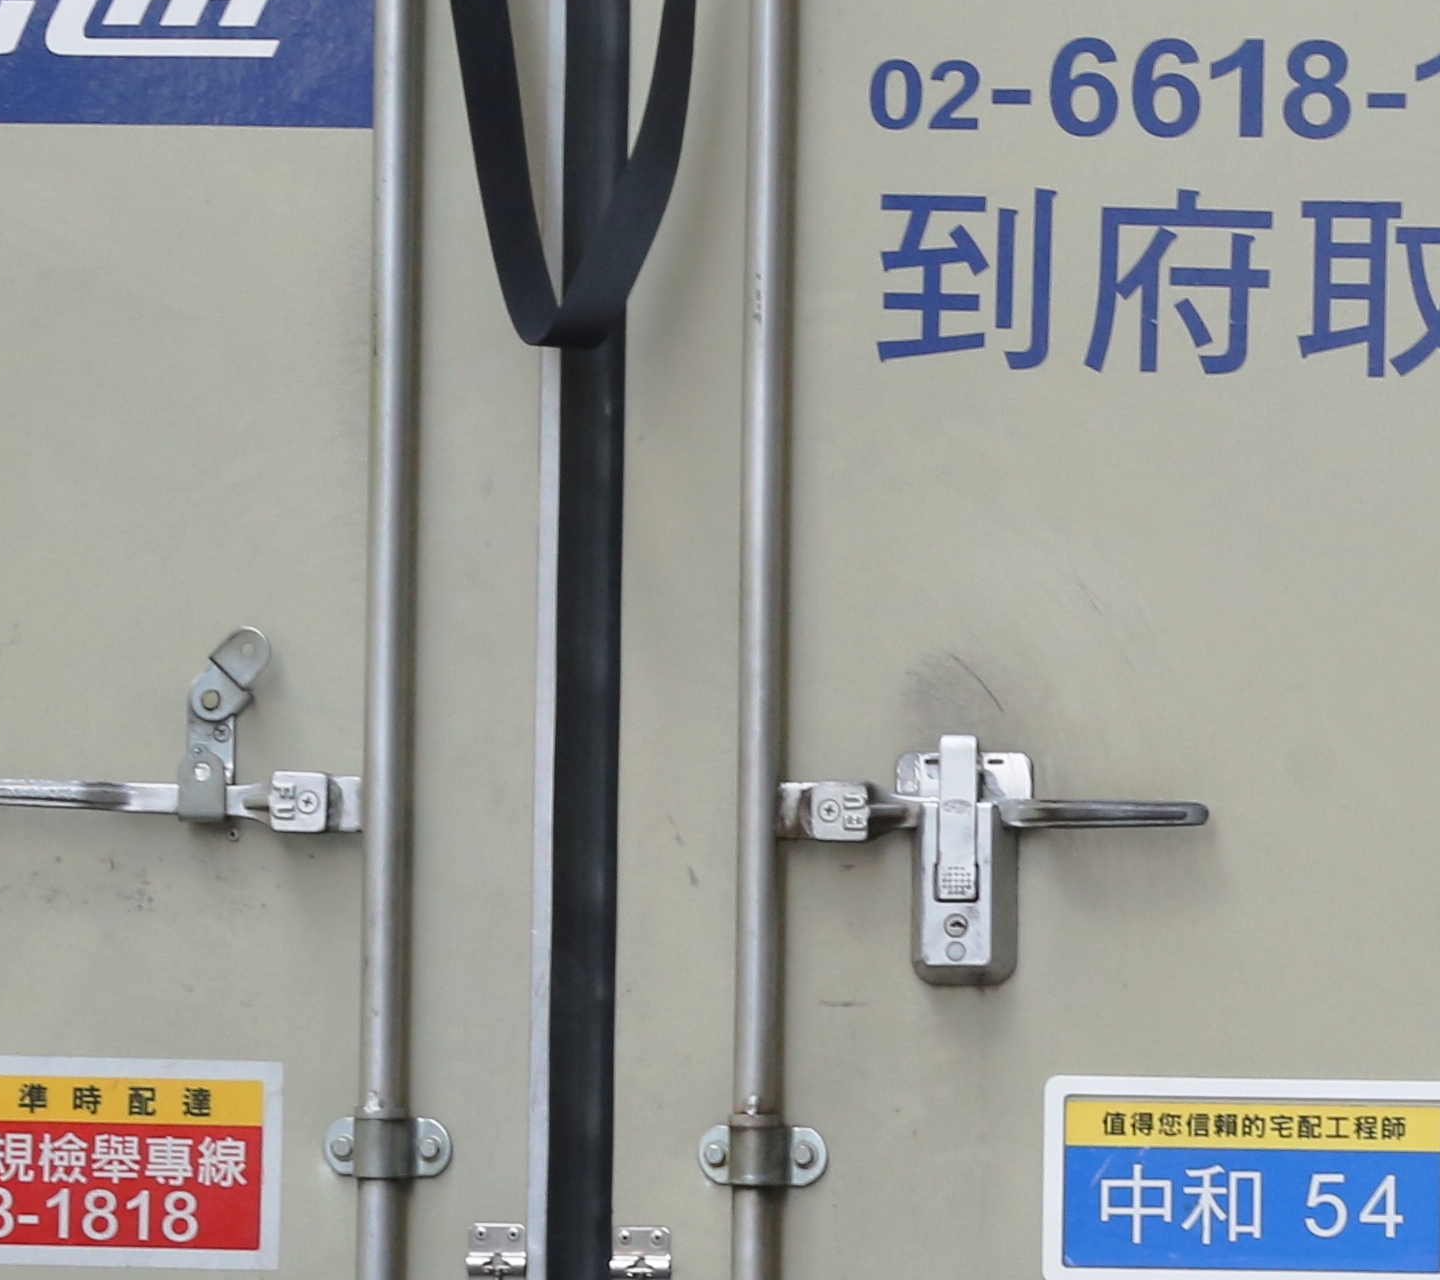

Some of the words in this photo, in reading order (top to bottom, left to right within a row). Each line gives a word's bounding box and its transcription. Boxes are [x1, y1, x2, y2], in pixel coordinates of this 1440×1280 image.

[18, 1082, 213, 1118] 準時配達
[1101, 1109, 1407, 1141] 值得您信賴的宅配工程師
[1099, 1163, 1263, 1245] 中和
[1303, 1172, 1405, 1239] 54
